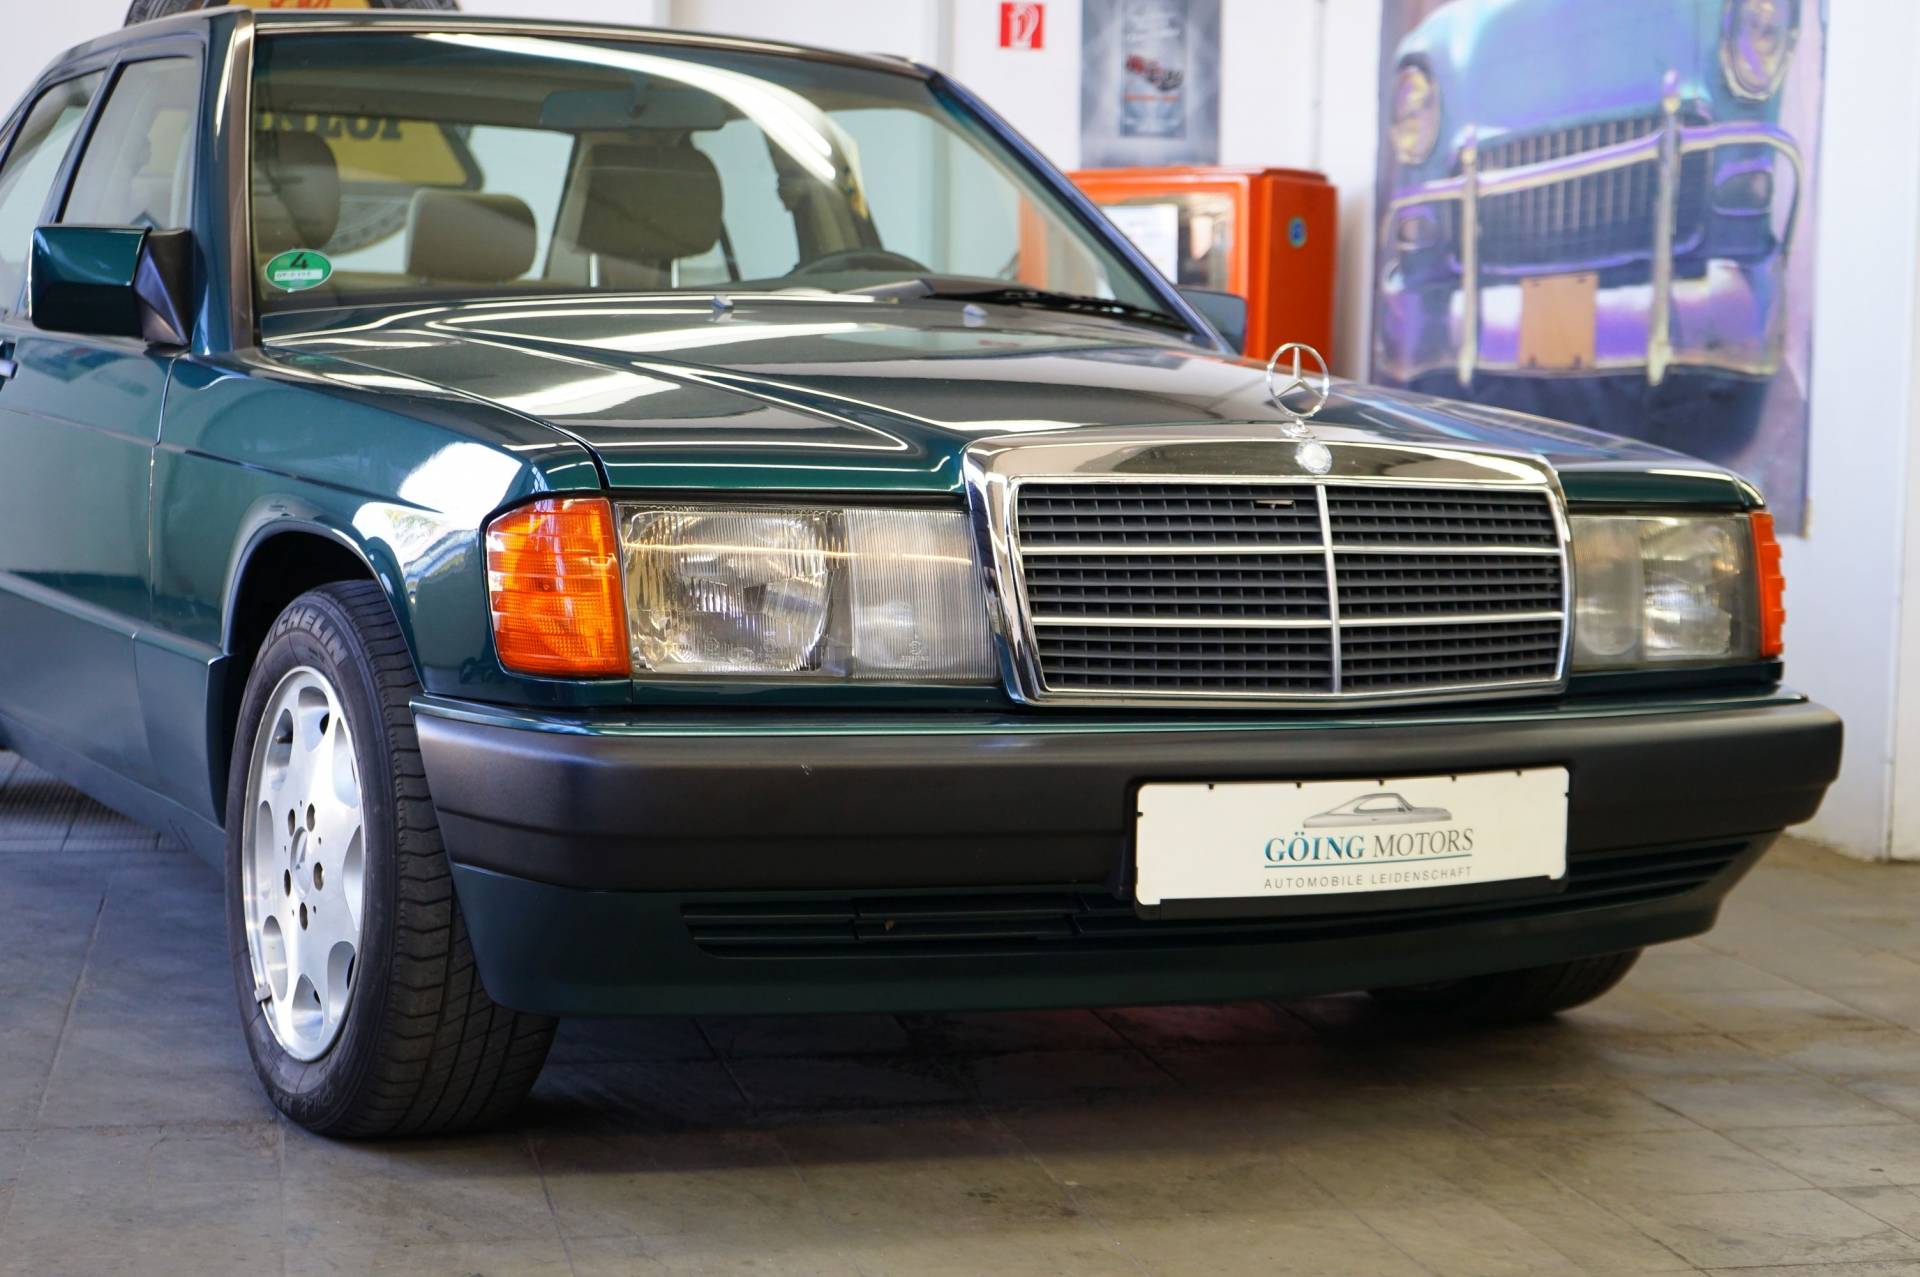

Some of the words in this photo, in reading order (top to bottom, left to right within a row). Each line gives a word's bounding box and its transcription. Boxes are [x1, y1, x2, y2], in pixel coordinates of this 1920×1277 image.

[291, 252, 307, 268] 4
[1265, 831, 1365, 862] GÖING
[1372, 828, 1474, 858] MOTORS
[1264, 874, 1364, 889] AUTOMOBILE
[1371, 866, 1473, 885] LEIDENSCHAFT
